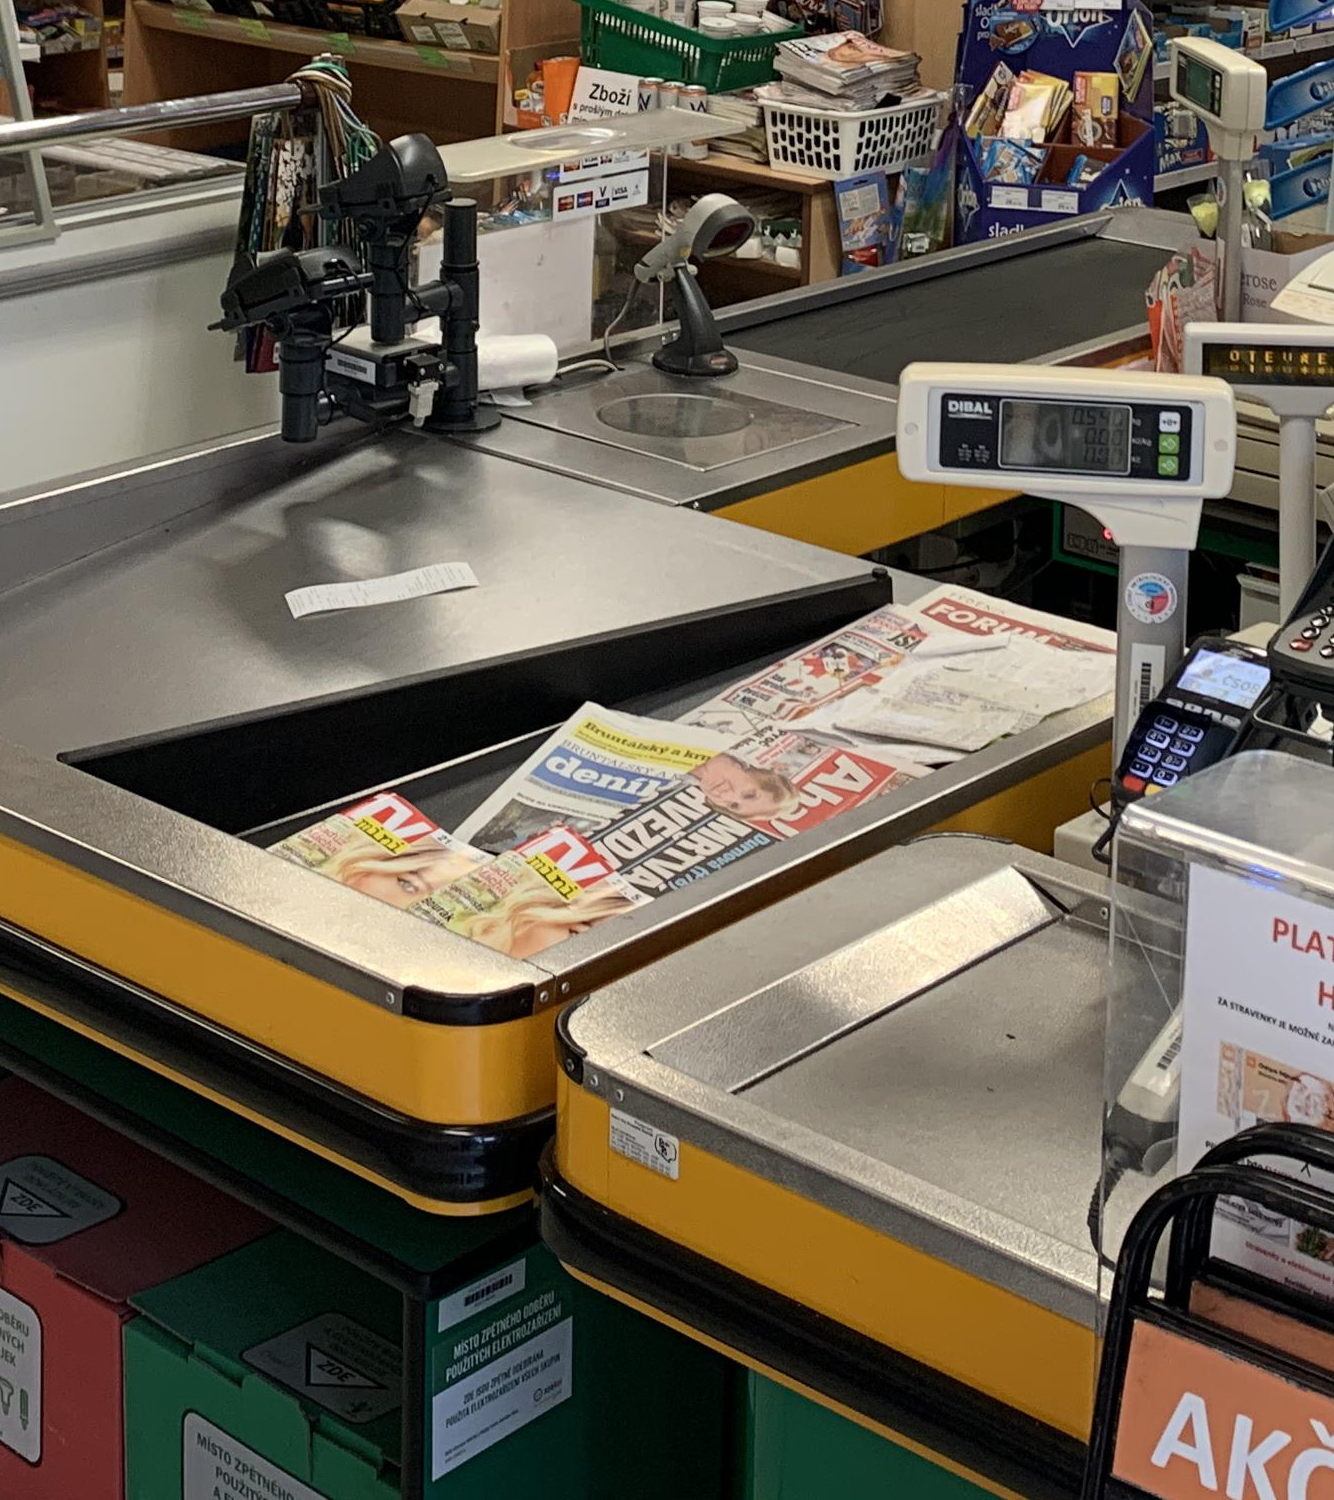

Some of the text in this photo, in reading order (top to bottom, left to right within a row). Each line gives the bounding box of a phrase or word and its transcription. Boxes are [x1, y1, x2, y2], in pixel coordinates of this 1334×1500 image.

[579, 102, 613, 117] prošlým
[589, 83, 632, 106] Zboží
[948, 400, 993, 415] DIBAL
[354, 817, 407, 854] mini
[622, 814, 753, 892] MRTVÁ
[527, 852, 582, 900] mini
[1229, 1000, 1278, 1026] STRAVENKY
[1289, 1021, 1319, 1043] MOŽNÉ
[10, 1193, 44, 1214] ZDE
[445, 1346, 492, 1383] POUŽITÝCH
[491, 1302, 564, 1358] ELEKTROZAŘÍZENÍ
[453, 1289, 556, 1361] MÍSTO ZPĚTNÉHO ODBĚRU
[316, 1359, 357, 1383] ZDE
[196, 1432, 295, 1500] MÍSTO ZPĚTNÉHO
